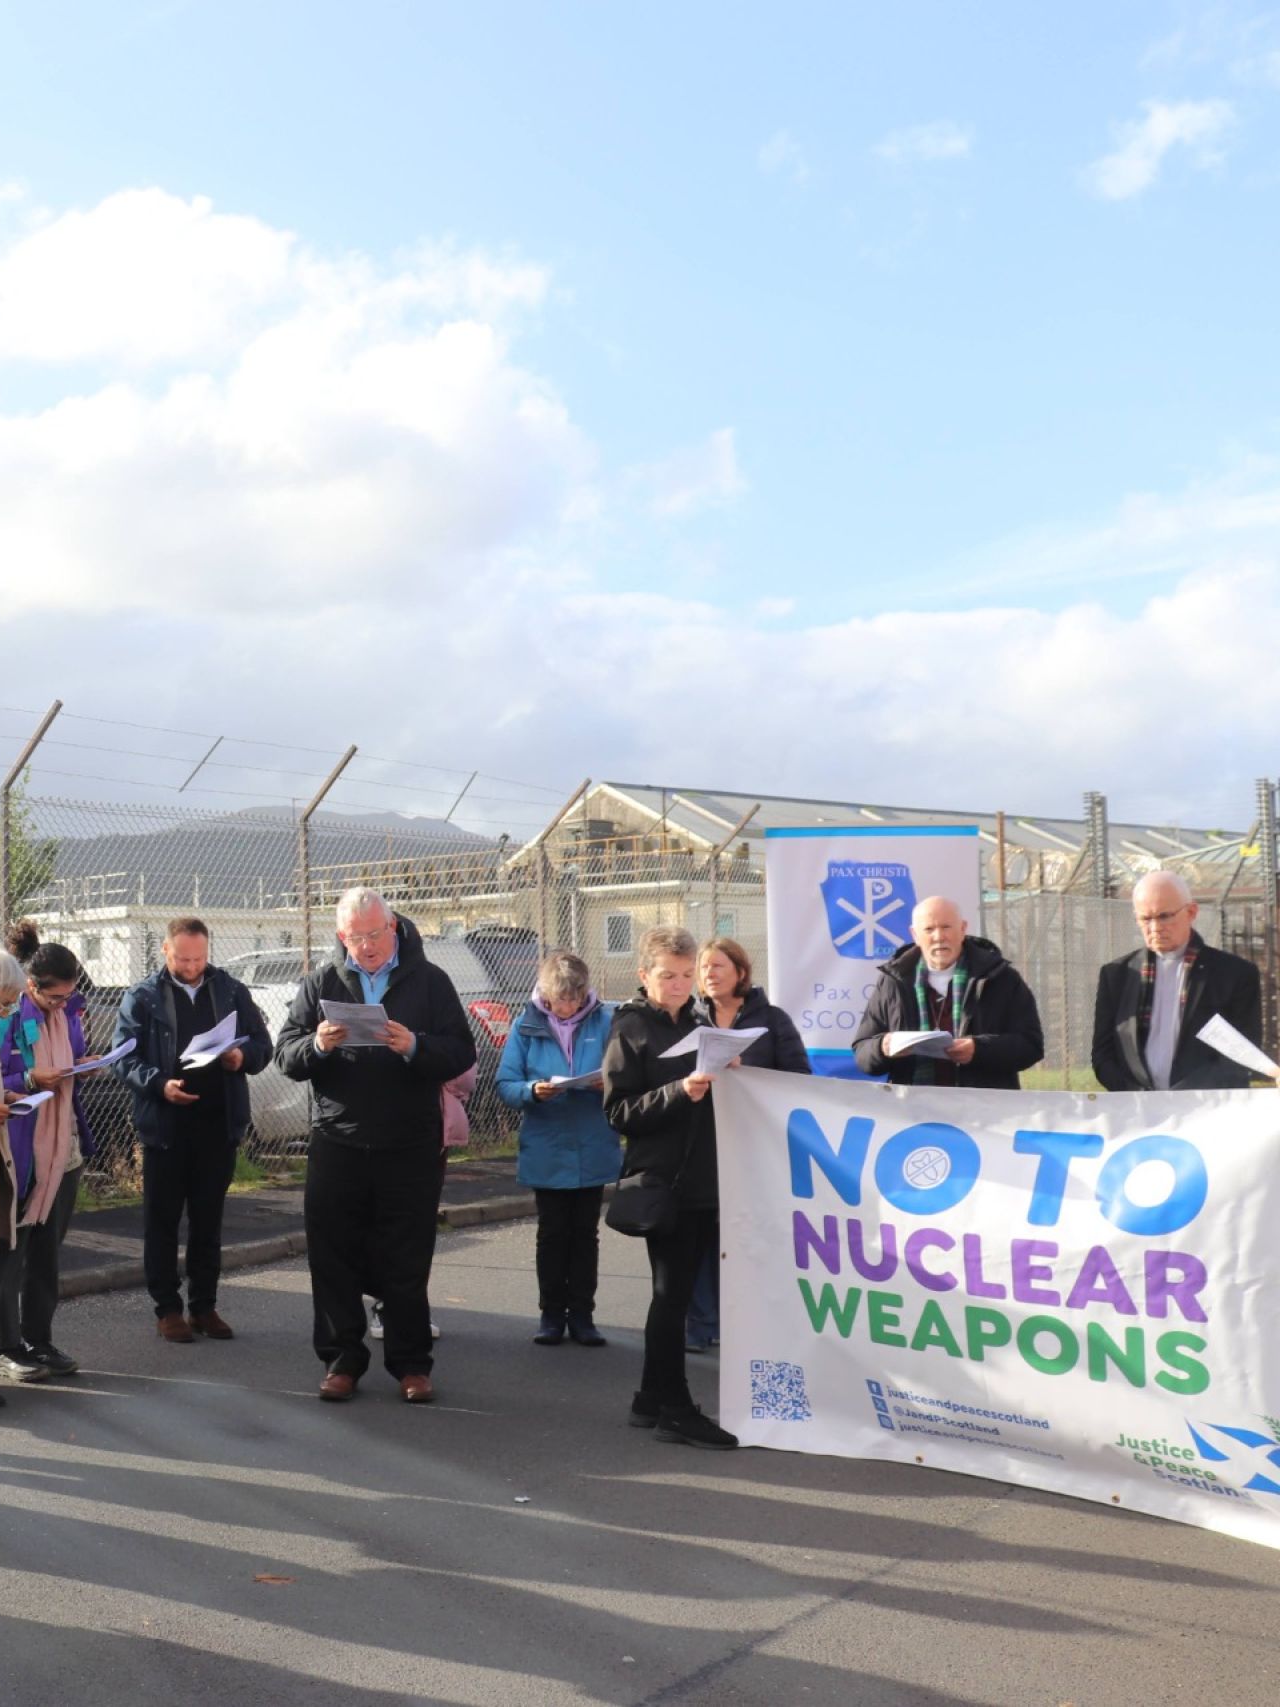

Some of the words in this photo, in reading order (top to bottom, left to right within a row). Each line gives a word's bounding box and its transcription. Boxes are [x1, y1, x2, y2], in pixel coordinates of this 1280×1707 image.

[831, 867, 854, 877] PAX
[857, 866, 907, 877] CHRISTI
[814, 983, 850, 1000] Pax
[787, 1108, 981, 1215] NO
[1014, 1130, 1209, 1236] TO
[794, 1211, 1209, 1323] NUCLEAR
[799, 1278, 1211, 1395] WEAPONS
[887, 1386, 1049, 1429] justiceandpeacescotland
[1116, 1433, 1195, 1461] Justice
